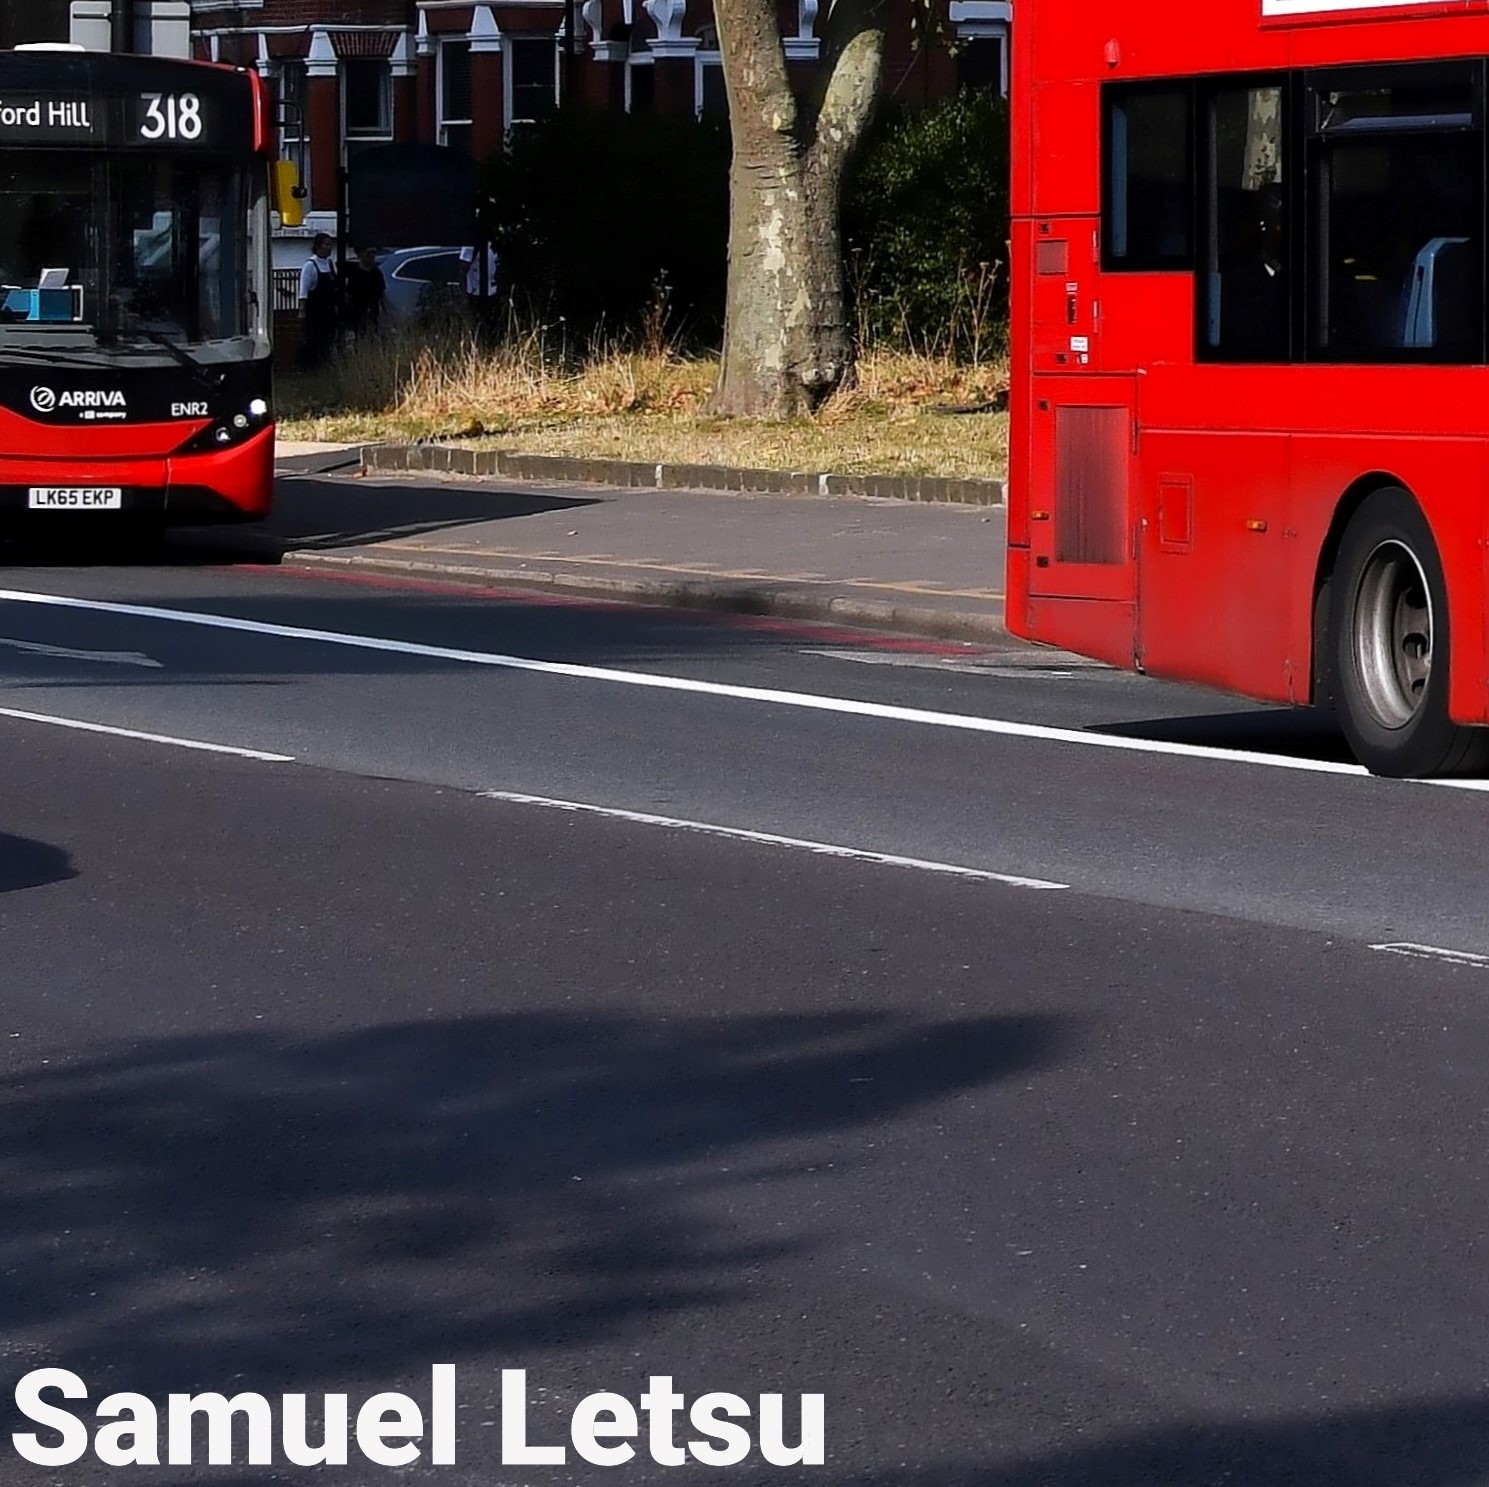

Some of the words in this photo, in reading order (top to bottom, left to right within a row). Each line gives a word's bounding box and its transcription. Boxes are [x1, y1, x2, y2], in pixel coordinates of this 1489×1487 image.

[0, 100, 40, 126] ord
[49, 101, 90, 127] Hill
[140, 92, 202, 139] 318
[59, 391, 127, 407] ARRIVA
[171, 402, 208, 416] ENR2
[36, 490, 78, 506] LK65
[82, 489, 114, 505] EKP
